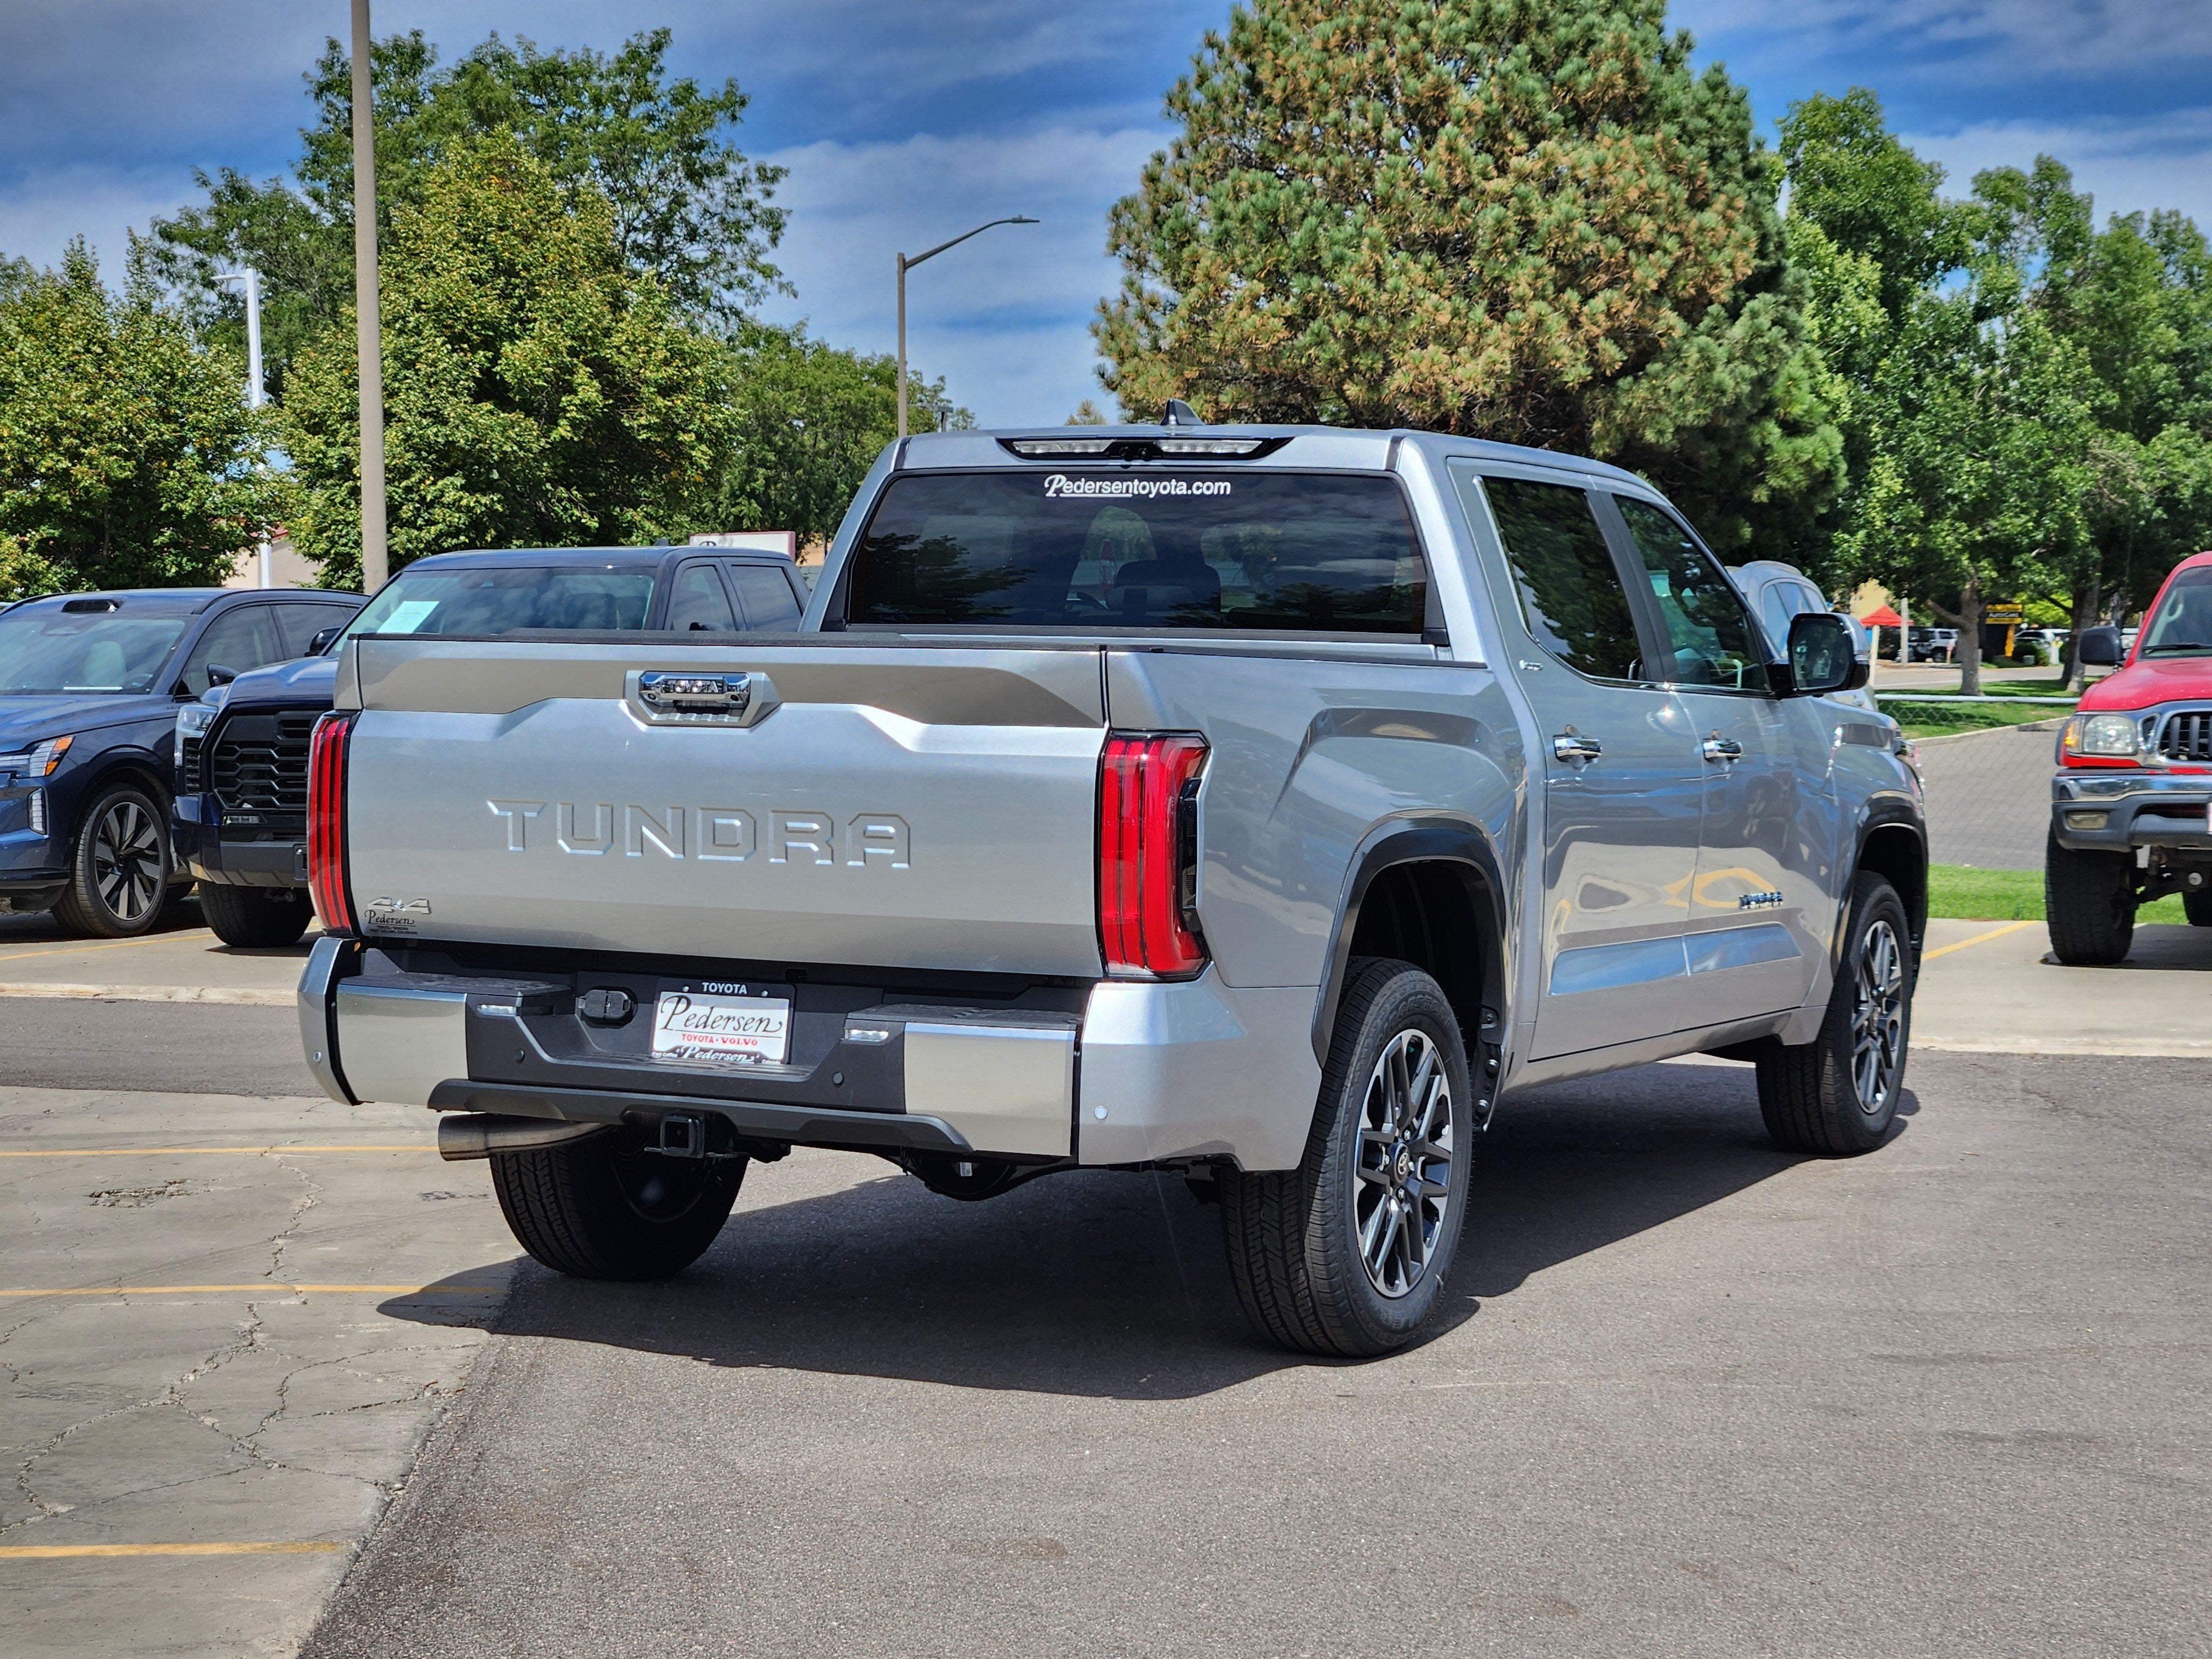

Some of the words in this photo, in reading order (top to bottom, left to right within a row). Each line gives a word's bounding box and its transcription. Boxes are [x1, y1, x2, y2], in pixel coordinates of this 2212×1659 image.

[1044, 474, 1231, 498] Pedersentoyota.com
[666, 680, 718, 693] TOYOTA
[487, 799, 911, 868] TUNDRA
[364, 910, 415, 925] Pedersen
[702, 982, 748, 994] TOYOTA
[659, 995, 782, 1033] Pedersen
[681, 1034, 714, 1044] TOYOTA
[720, 1036, 758, 1046] VOLVO
